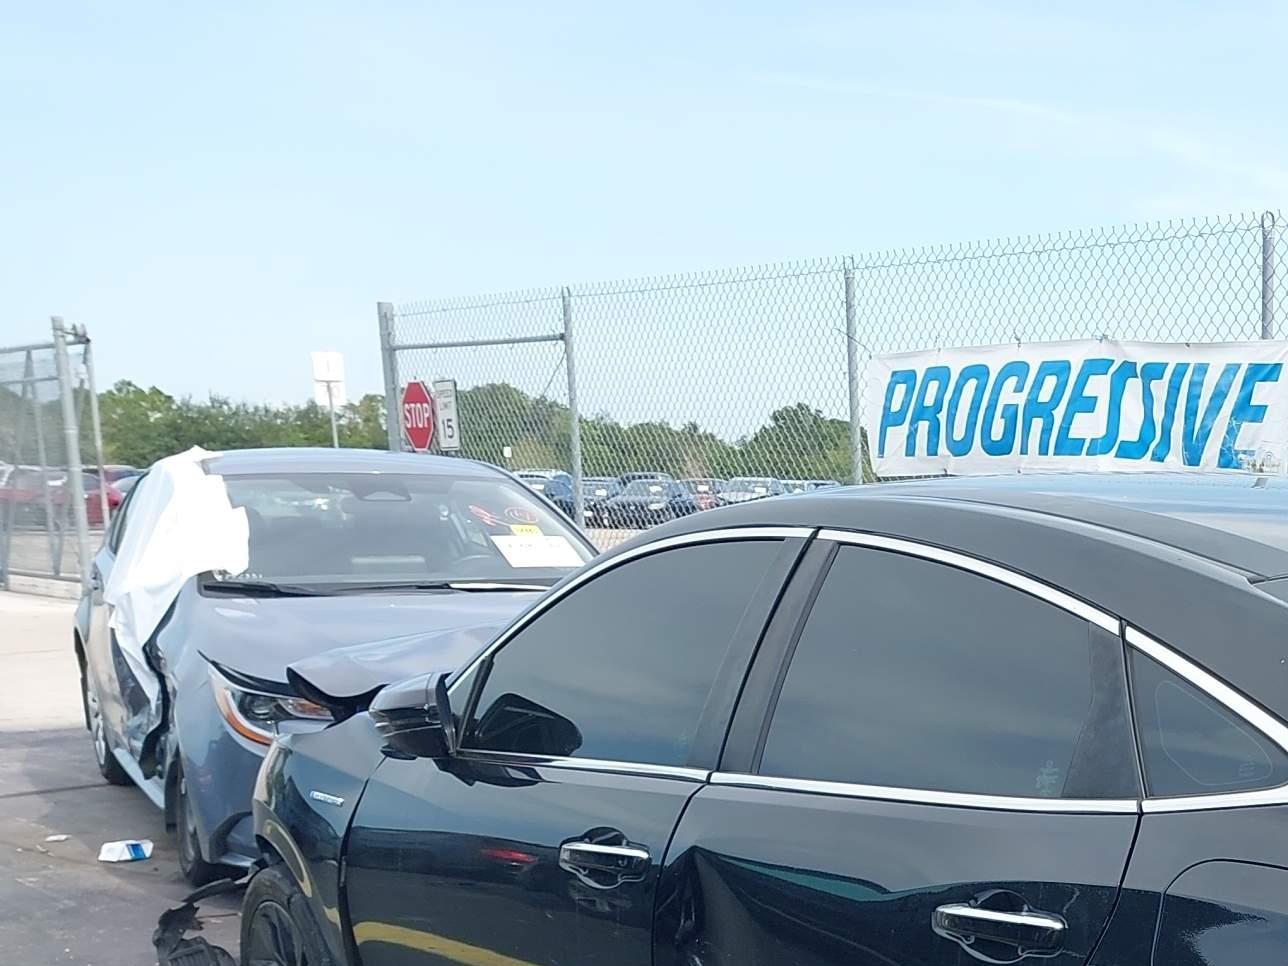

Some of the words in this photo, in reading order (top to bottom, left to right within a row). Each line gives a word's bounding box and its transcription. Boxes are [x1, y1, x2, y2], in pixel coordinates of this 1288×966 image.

[404, 403, 429, 428] STOP
[877, 358, 1284, 469] PROGRESSIVE
[442, 418, 455, 439] 15
